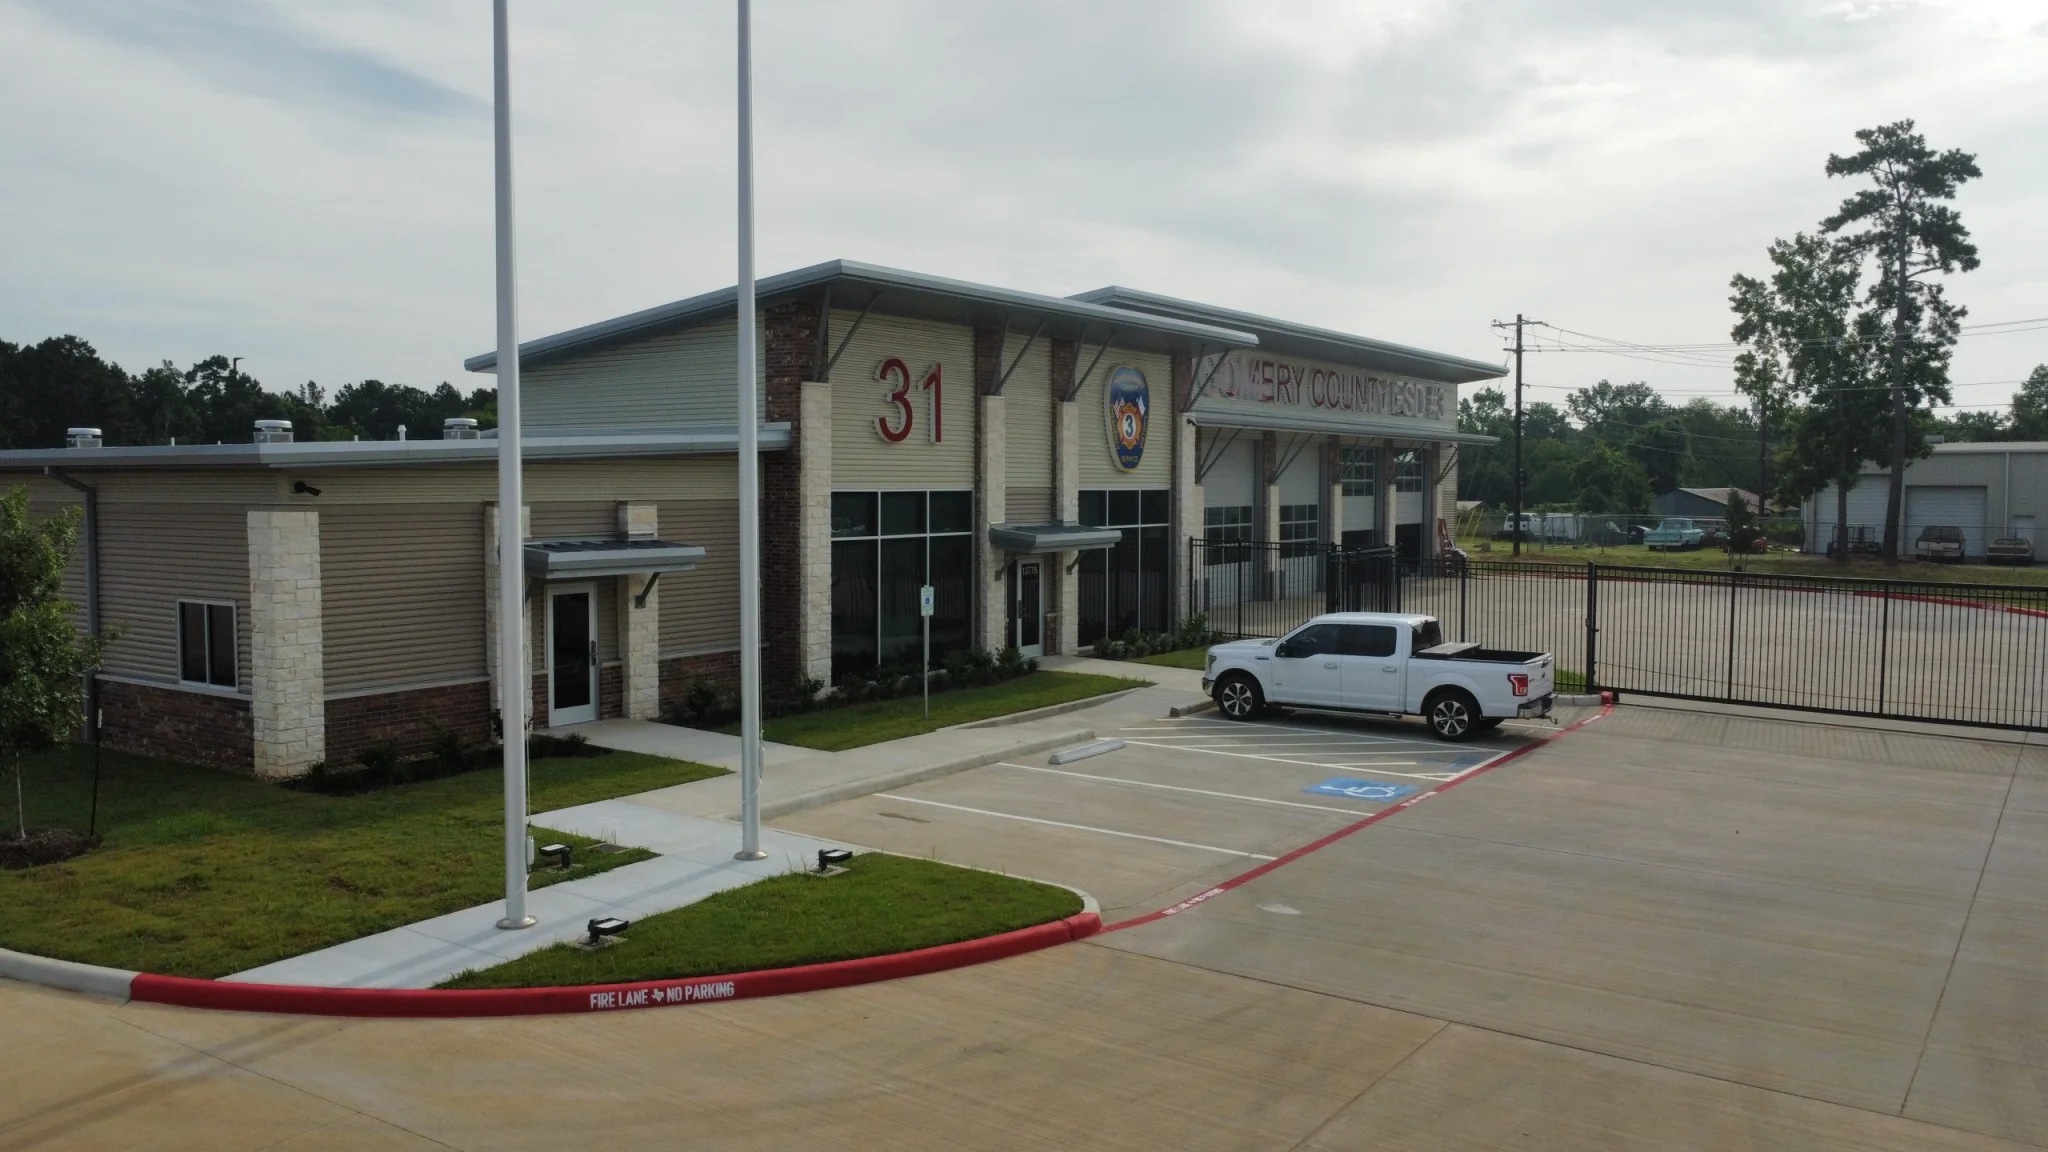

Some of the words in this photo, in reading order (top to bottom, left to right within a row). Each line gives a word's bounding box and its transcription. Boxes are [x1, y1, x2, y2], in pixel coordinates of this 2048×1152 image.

[874, 356, 942, 444] 31
[1125, 414, 1133, 433] 3
[590, 991, 616, 1009] FIRE
[618, 989, 649, 1007] LANE
[666, 986, 682, 1003] NO
[685, 981, 735, 1000] PARKING
